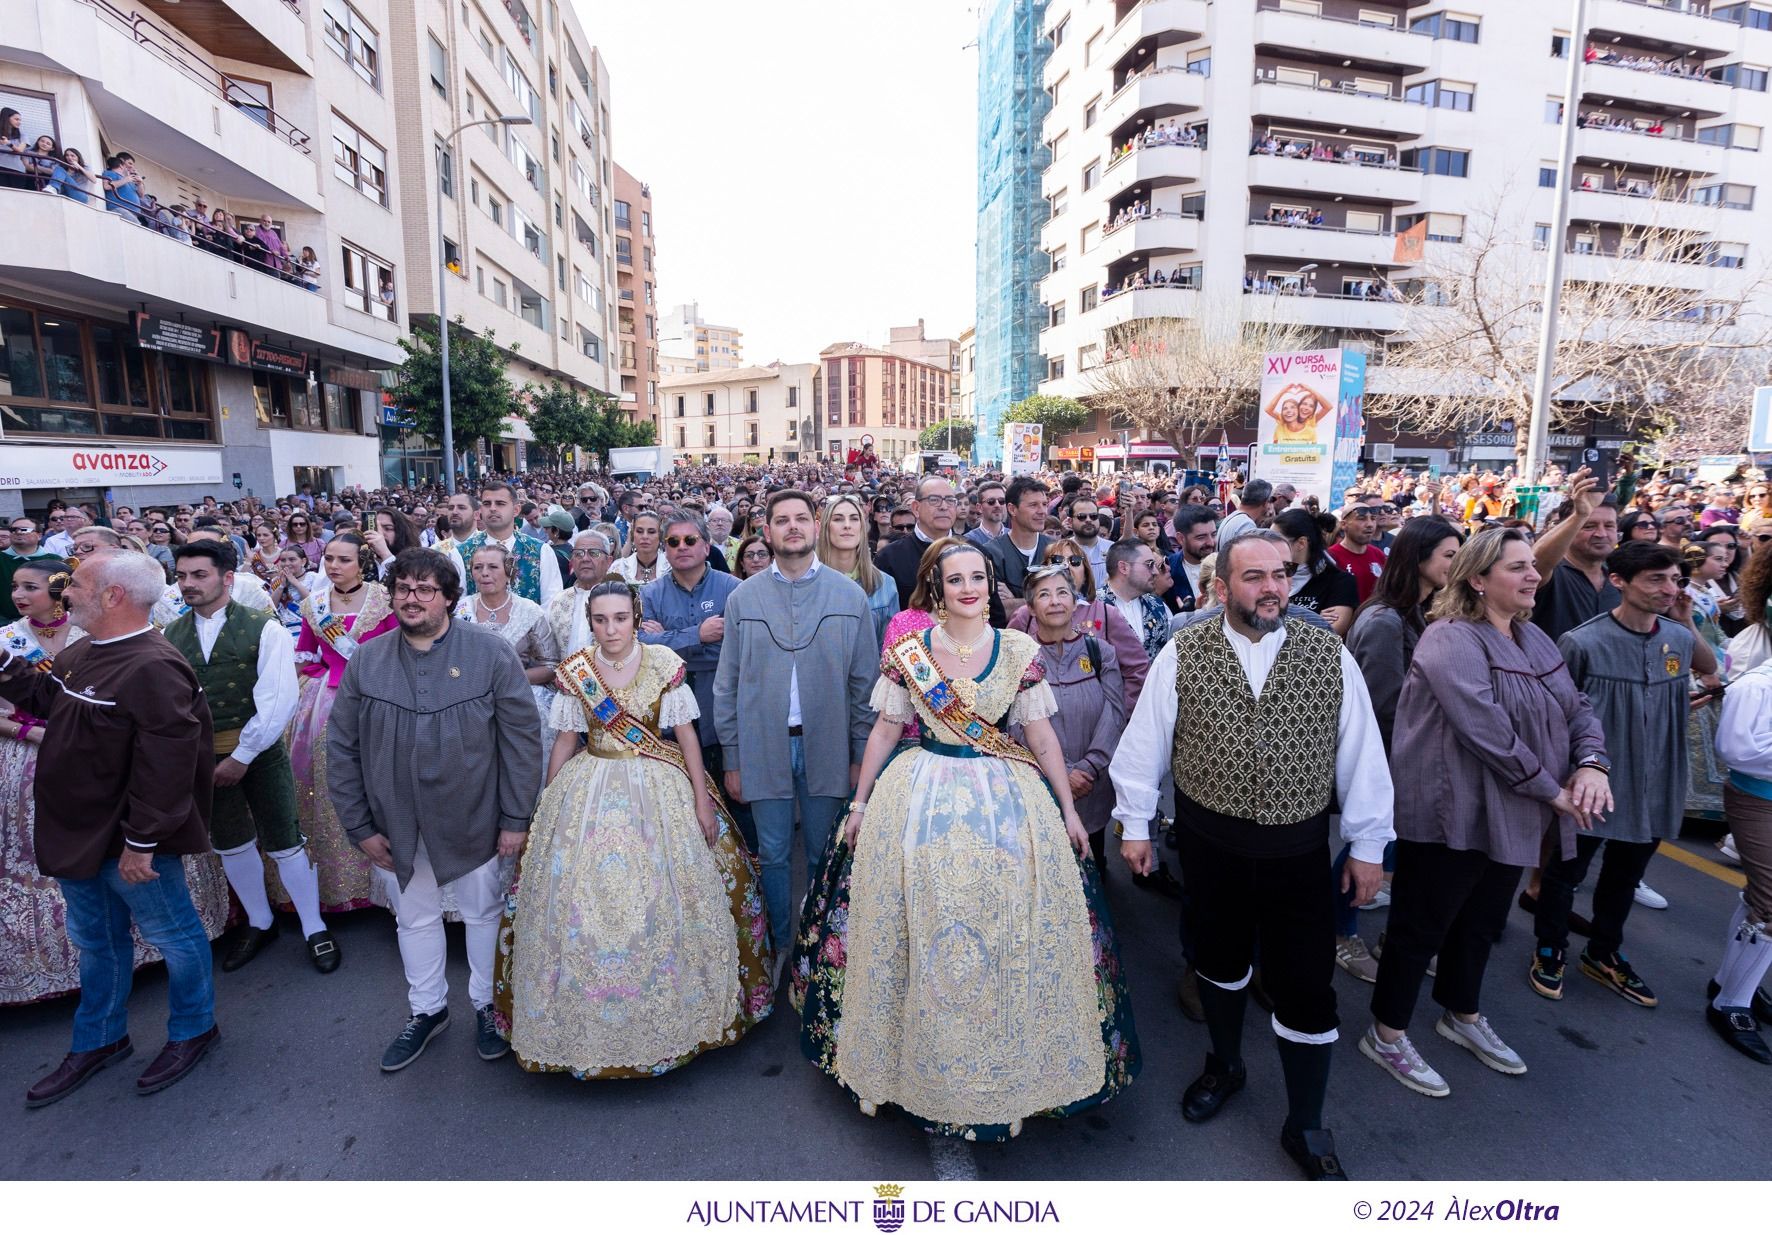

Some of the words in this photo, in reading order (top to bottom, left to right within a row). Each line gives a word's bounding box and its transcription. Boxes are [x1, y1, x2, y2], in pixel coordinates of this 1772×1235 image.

[1267, 357, 1292, 375] XV
[1295, 355, 1325, 365] CURSA
[1311, 363, 1337, 373] DONA
[72, 452, 150, 470] avanza
[900, 645, 918, 657] 2024
[570, 661, 586, 674] 2024
